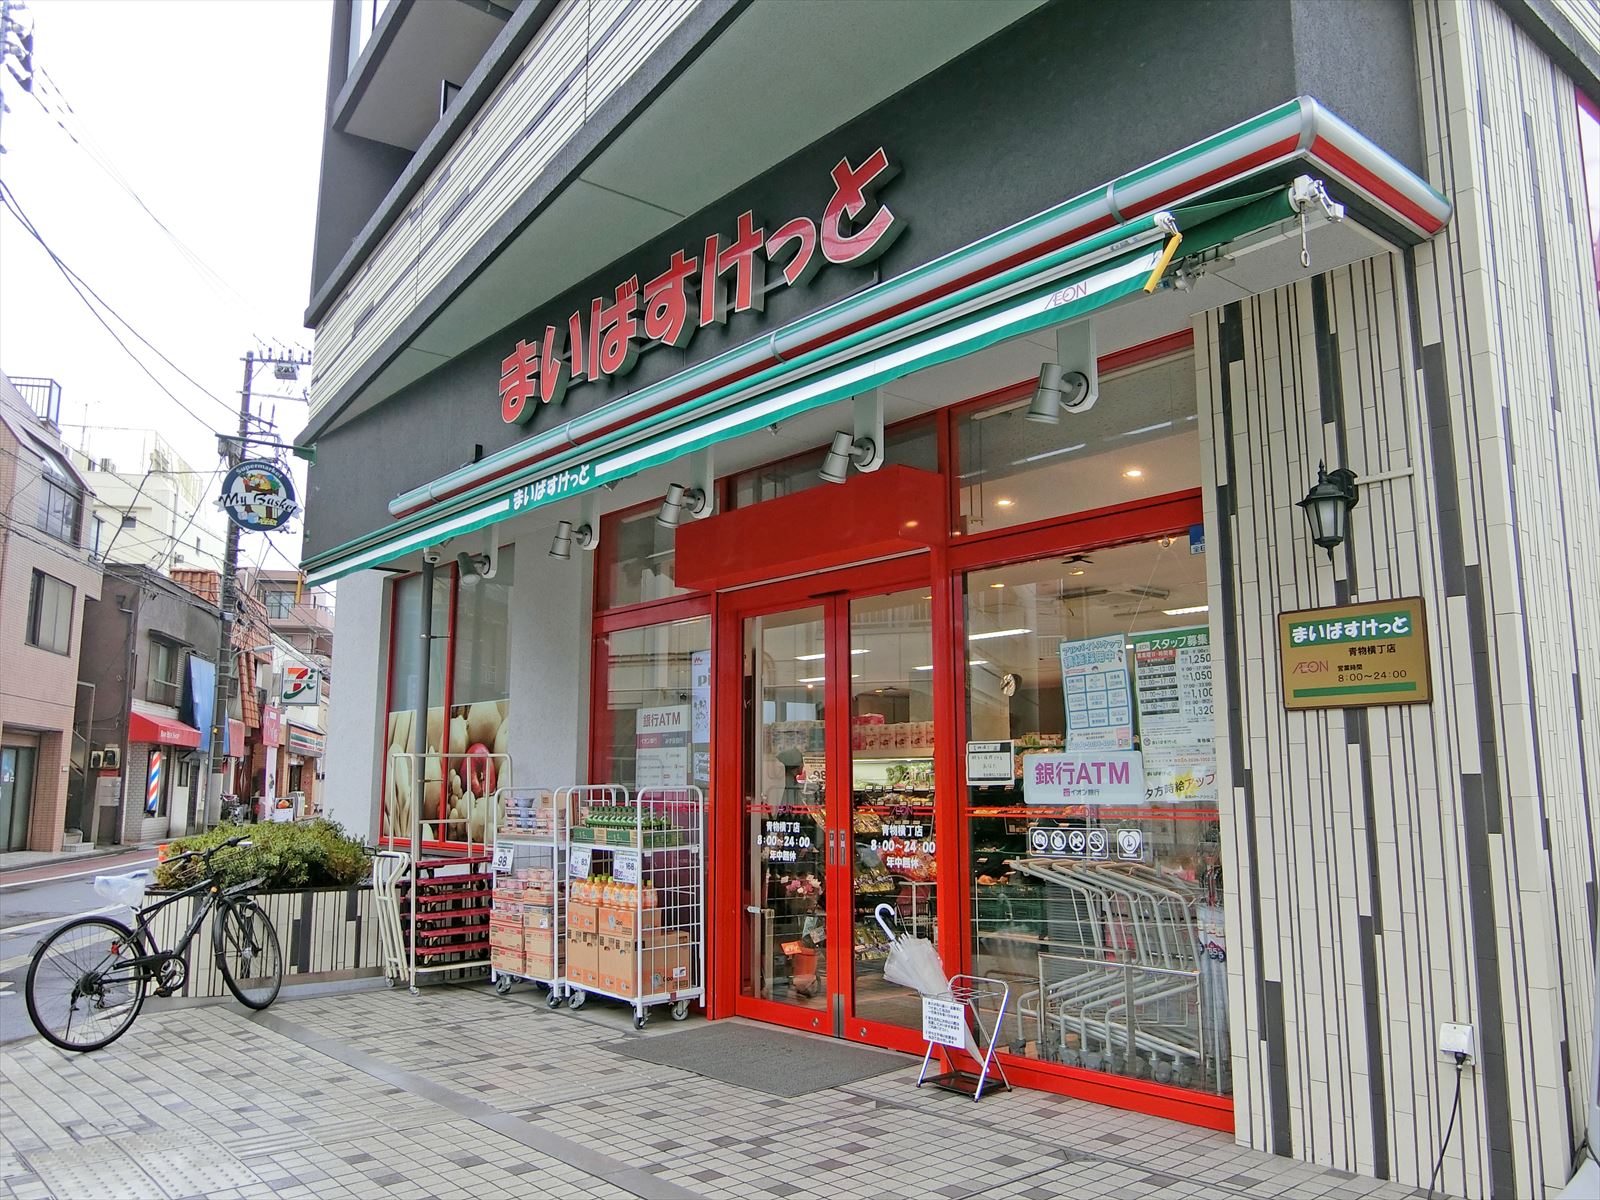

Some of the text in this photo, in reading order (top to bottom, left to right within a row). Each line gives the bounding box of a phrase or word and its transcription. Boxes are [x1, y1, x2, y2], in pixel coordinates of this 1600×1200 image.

[499, 146, 895, 424] まいばすけっと
[235, 463, 283, 479] Supermarket
[513, 464, 590, 511] まいばすけっと
[218, 492, 298, 514] My Basket
[1291, 616, 1409, 644] まいばすけっと
[1151, 633, 1209, 651] スタッフ募集
[1348, 643, 1396, 657] 青物横丁店
[1188, 653, 1211, 665] 1,250
[1337, 664, 1363, 672] 営業時間
[1189, 670, 1213, 682] 1,050
[642, 711, 681, 728] 銀行ATM
[1034, 761, 1130, 786] 銀行ATM
[1071, 788, 1100, 797] イオン銀行
[766, 821, 800, 834] 青物横丁店
[881, 824, 923, 837] 青物横丁店
[497, 856, 507, 867] 98
[769, 850, 797, 862] 年中無休
[886, 856, 920, 869] 年中無休
